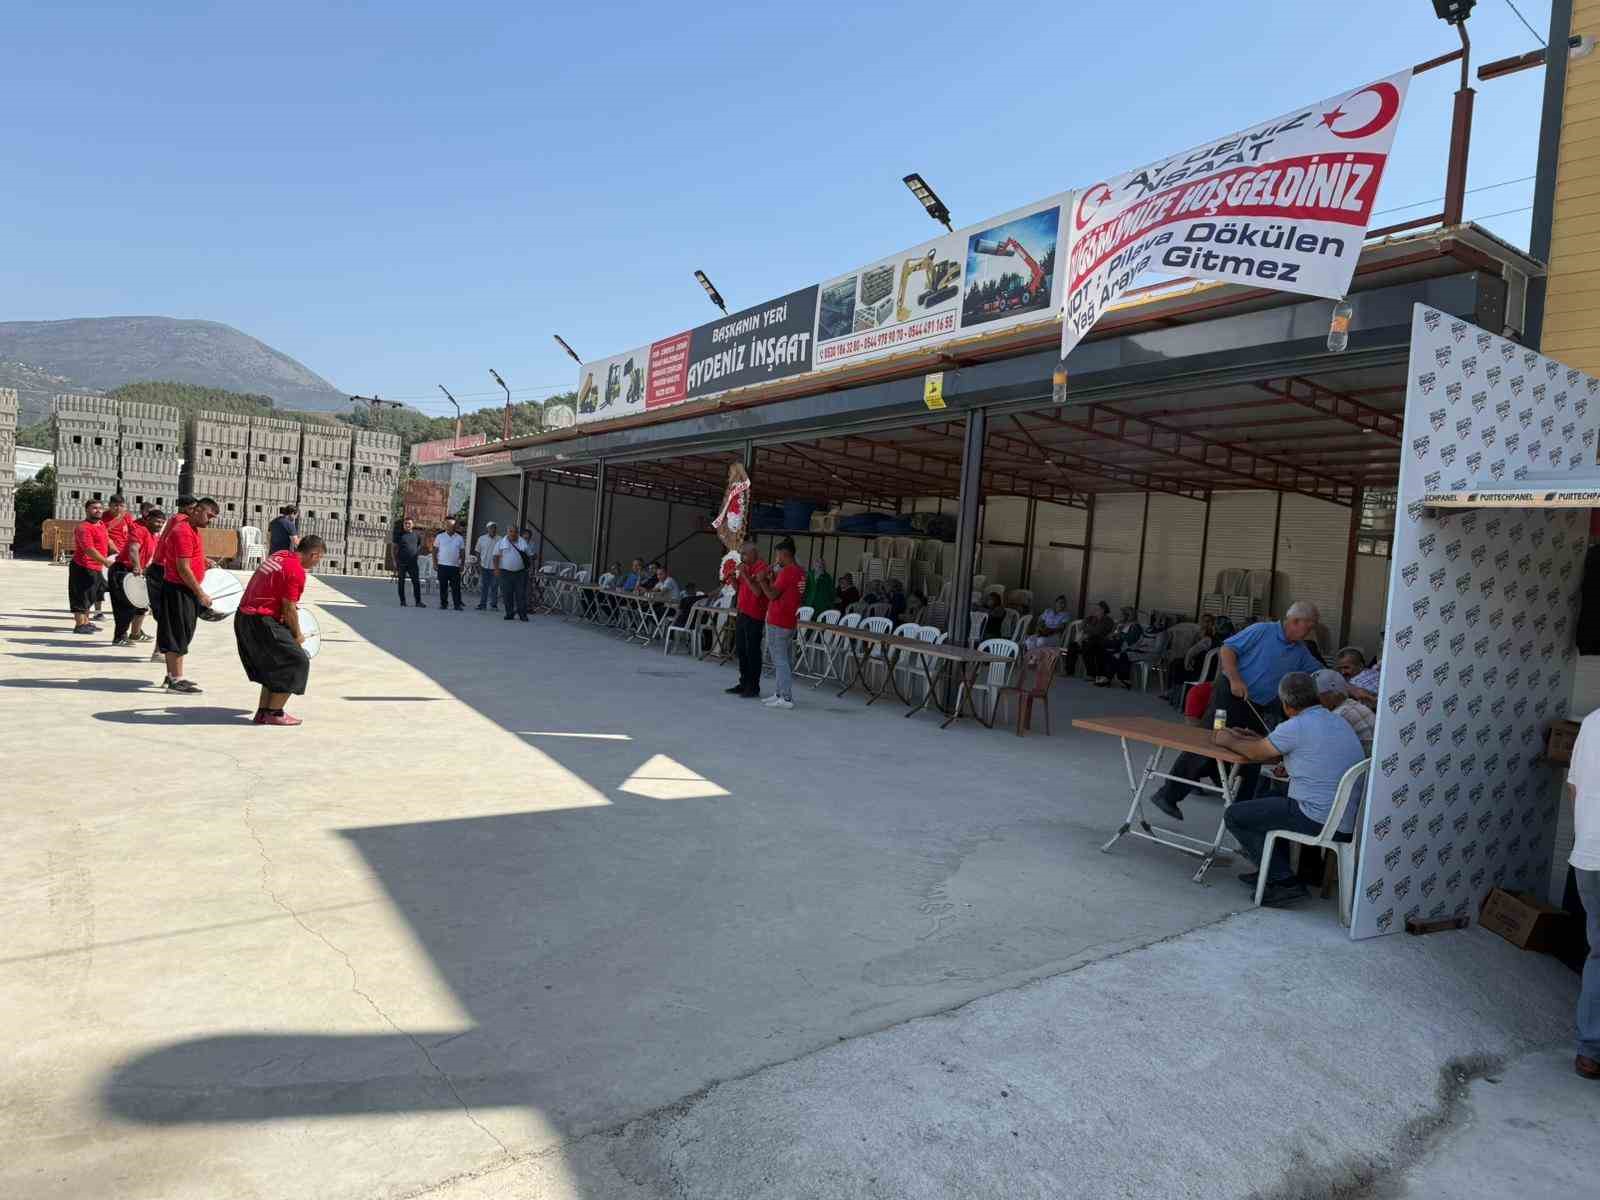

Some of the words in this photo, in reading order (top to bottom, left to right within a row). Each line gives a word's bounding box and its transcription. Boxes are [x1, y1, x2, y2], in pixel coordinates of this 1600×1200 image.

[1170, 154, 1375, 217] HOŞGELDİNİZ
[1107, 231, 1175, 278] Pilava
[1184, 222, 1345, 258] Dökülen
[1073, 300, 1096, 336] Yağ
[1099, 255, 1152, 311] Araya
[1161, 246, 1301, 283] Gitmez
[712, 313, 760, 344] BAŞKANIN
[763, 301, 788, 329] YERİ
[686, 341, 747, 393] AYDENİZ
[749, 332, 811, 372] İNŞAAT
